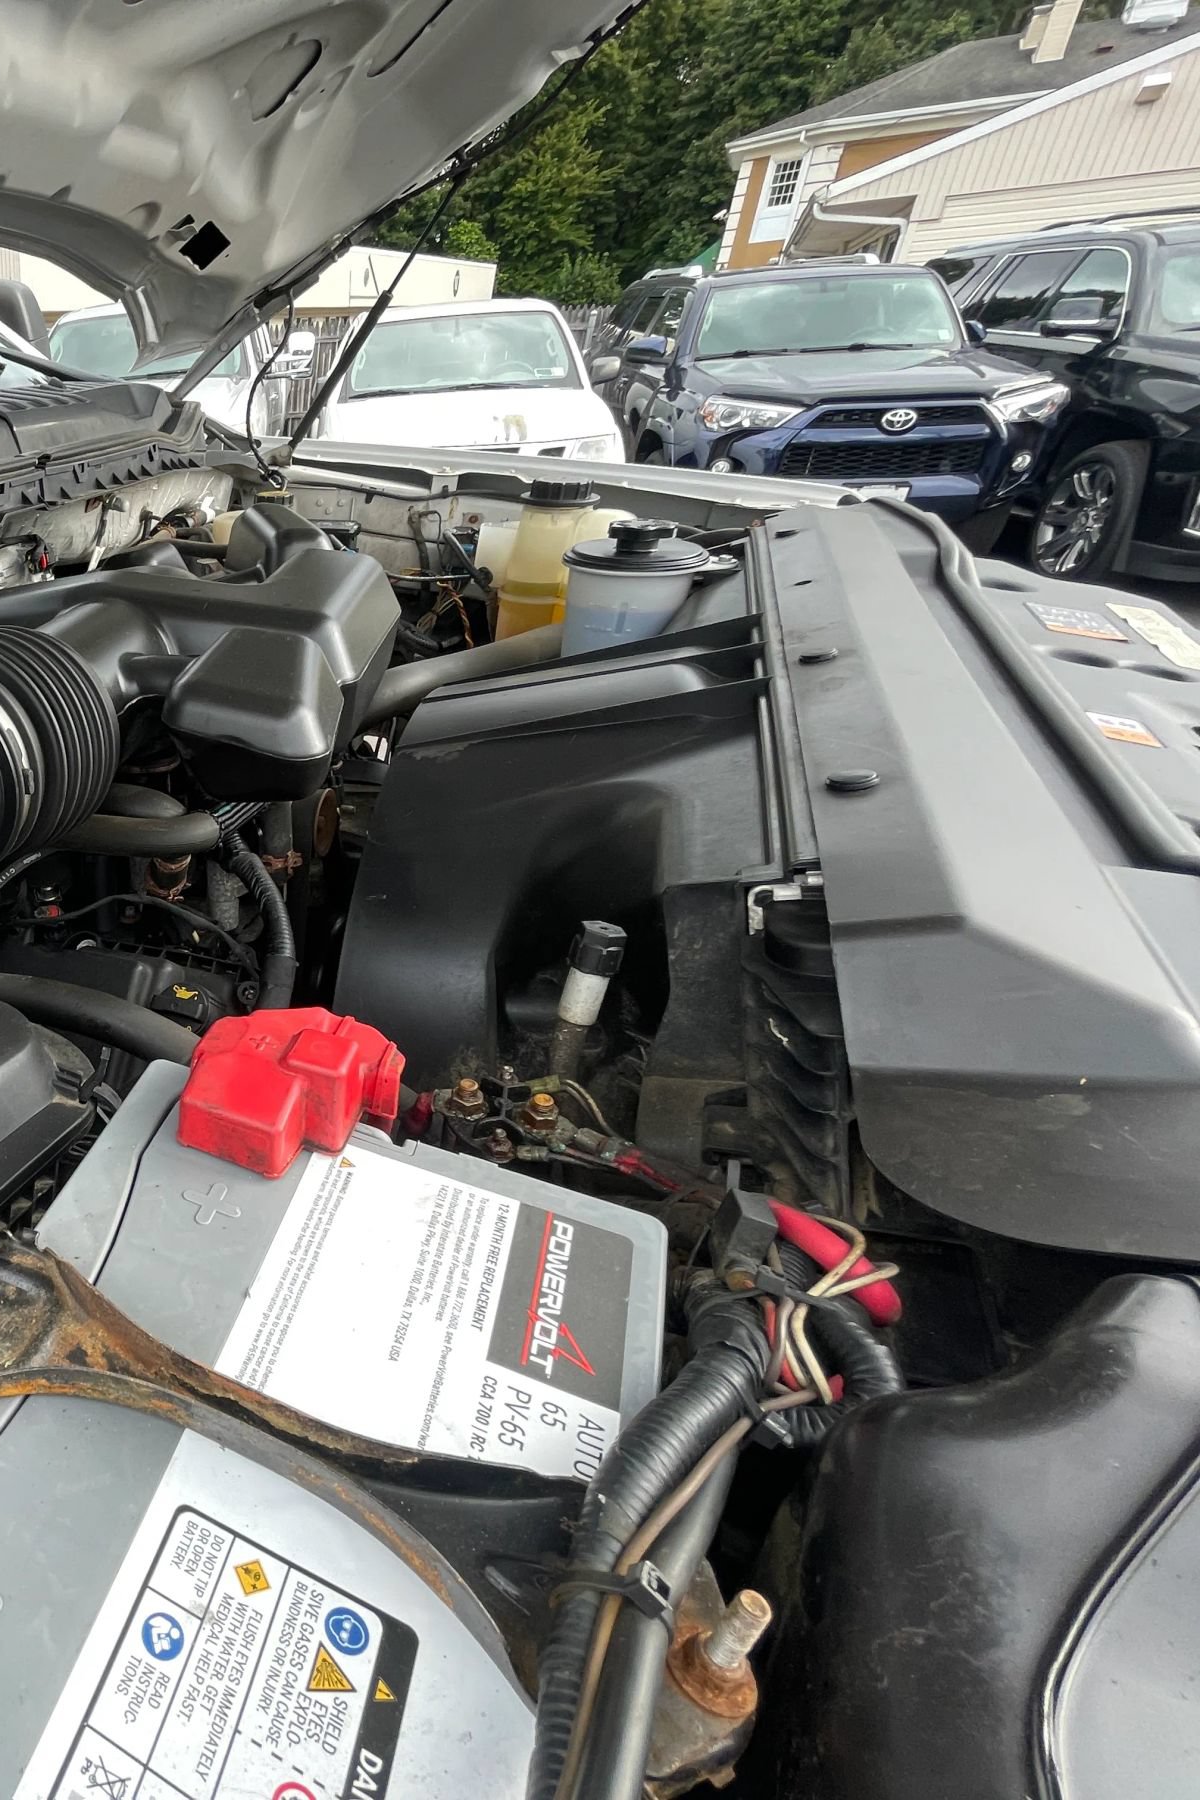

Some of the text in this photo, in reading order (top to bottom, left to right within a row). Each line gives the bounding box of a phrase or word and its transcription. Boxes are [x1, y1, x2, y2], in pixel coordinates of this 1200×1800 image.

[436, 1183, 449, 1202] 14221
[445, 1187, 462, 1221] Distributed
[427, 1210, 441, 1229] Dallas
[440, 1219, 453, 1229] by
[472, 1203, 487, 1225] replace
[433, 1228, 451, 1260] Interstate
[453, 1236, 466, 1255] dealer
[470, 1224, 482, 1242] under
[416, 1248, 430, 1266] Suite
[470, 1202, 510, 1332] 12-MONTH FREE REPLACEMENT
[409, 1265, 424, 1286] 1000,
[423, 1258, 442, 1292] Batteries,
[460, 1268, 471, 1281] call
[401, 1284, 419, 1310] Dallas,
[527, 1219, 573, 1376] POWERVOLT
[399, 1309, 412, 1321] TX
[392, 1320, 408, 1345] 75254
[443, 1330, 454, 1345] see
[234, 1327, 265, 1381] www.P65Warning
[386, 1344, 401, 1363] USA
[256, 1365, 273, 1393] chemica
[479, 1374, 497, 1401] CCA
[414, 1344, 452, 1453] PowerVoltBatteries.com/war
[474, 1399, 492, 1427] 700
[539, 1399, 567, 1431] 65
[496, 1384, 532, 1451] PV-65
[468, 1431, 485, 1455] RC
[571, 1413, 605, 1486] AUTO
[168, 1518, 198, 1570] BATTERY.
[182, 1526, 211, 1577] OR OPEN
[191, 1533, 225, 1599] DO NOT TIP
[176, 1591, 235, 1723] MEDICAL HELP FAST.
[197, 1600, 249, 1715] WITH WATER. GET
[255, 1580, 308, 1716] BLINDNESS OR INJURY.
[113, 1652, 141, 1699] TIONS.
[264, 1587, 325, 1748] SIVE GASES CAN CAUSE
[119, 1661, 156, 1727] INSTRUC-
[145, 1671, 170, 1711] READ
[192, 1607, 263, 1783] FLUSH EYES IMMEDIATELY
[282, 1690, 312, 1751] EXPLO-
[303, 1699, 329, 1747] EYES.
[320, 1695, 349, 1756] SHIELD
[80, 1757, 93, 1775] Pb
